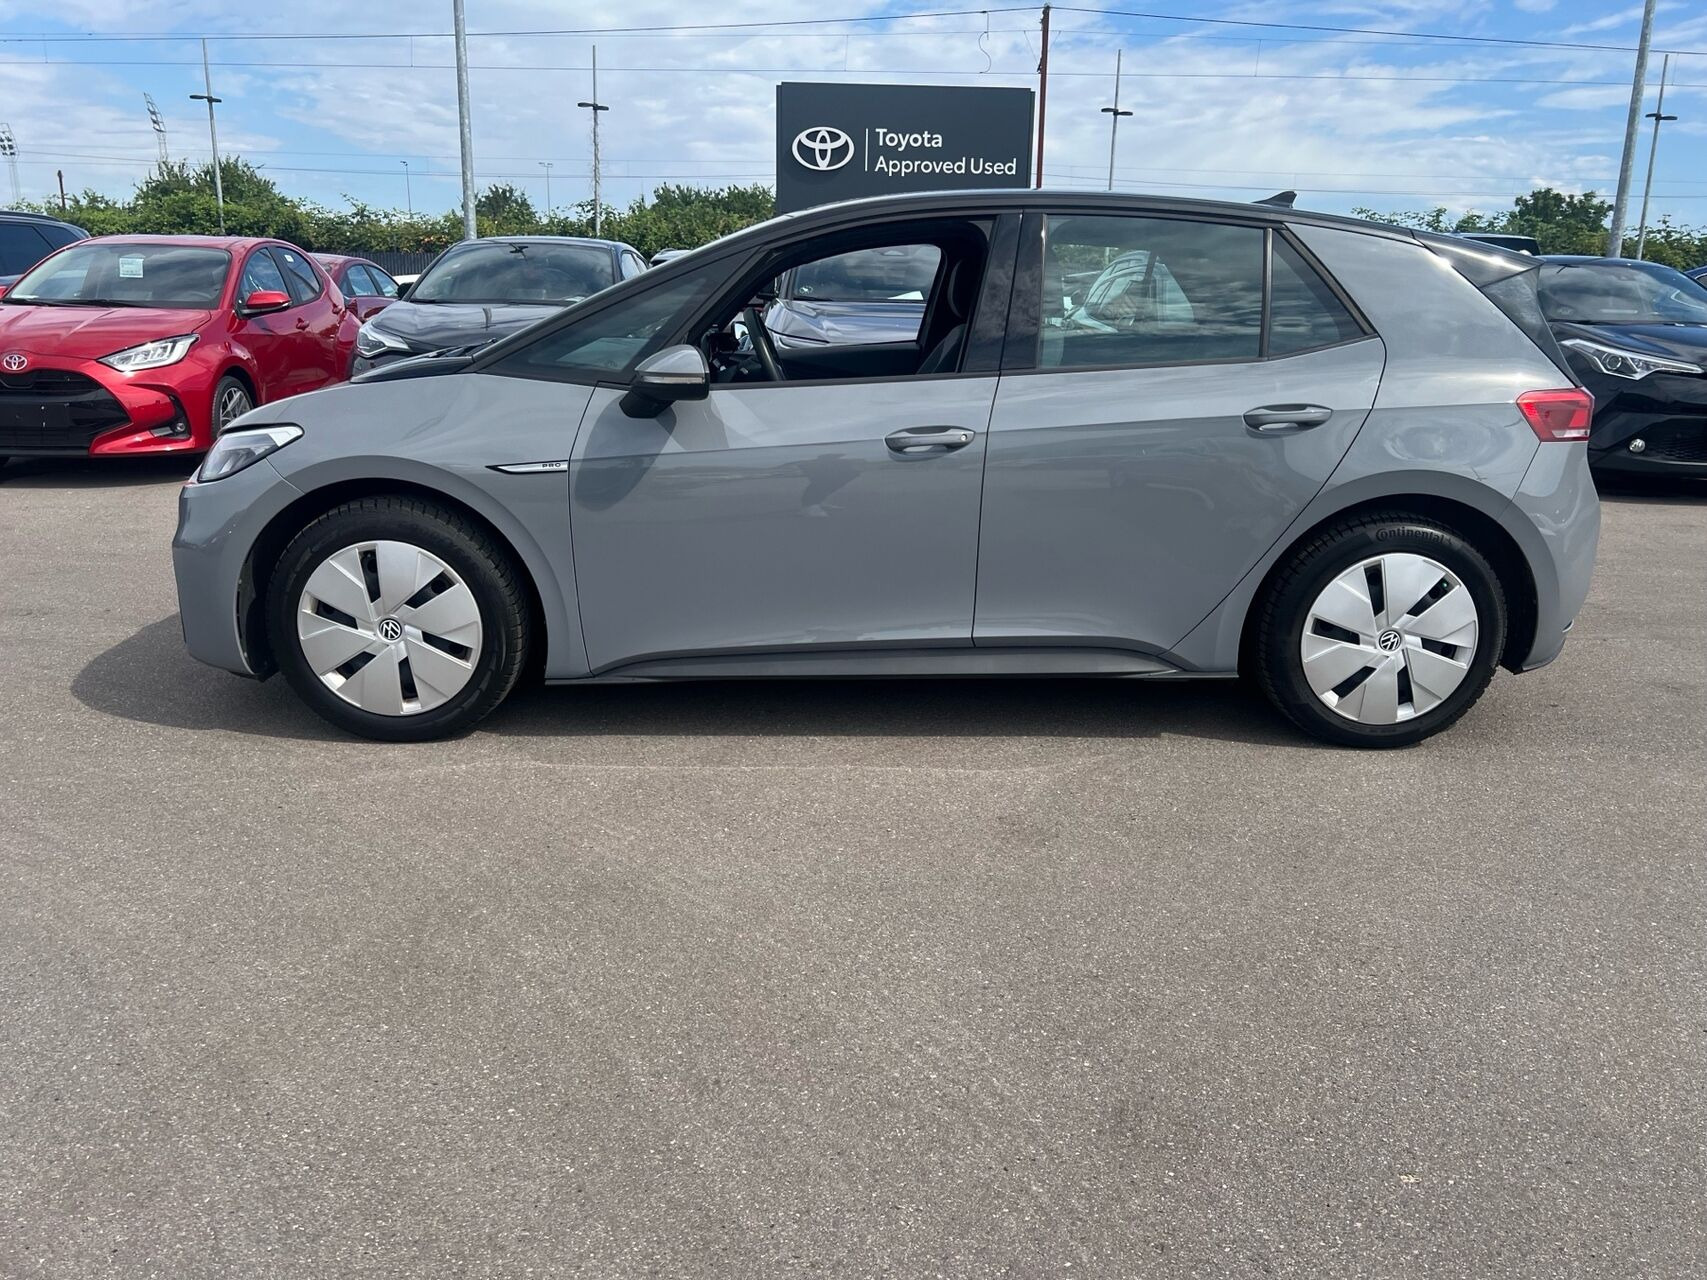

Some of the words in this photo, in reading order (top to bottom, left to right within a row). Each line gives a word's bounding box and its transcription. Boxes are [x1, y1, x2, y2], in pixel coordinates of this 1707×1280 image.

[875, 128, 943, 151] Toyota
[874, 155, 965, 176] Approved
[970, 158, 1017, 175] Used
[1376, 526, 1445, 544] Continental
